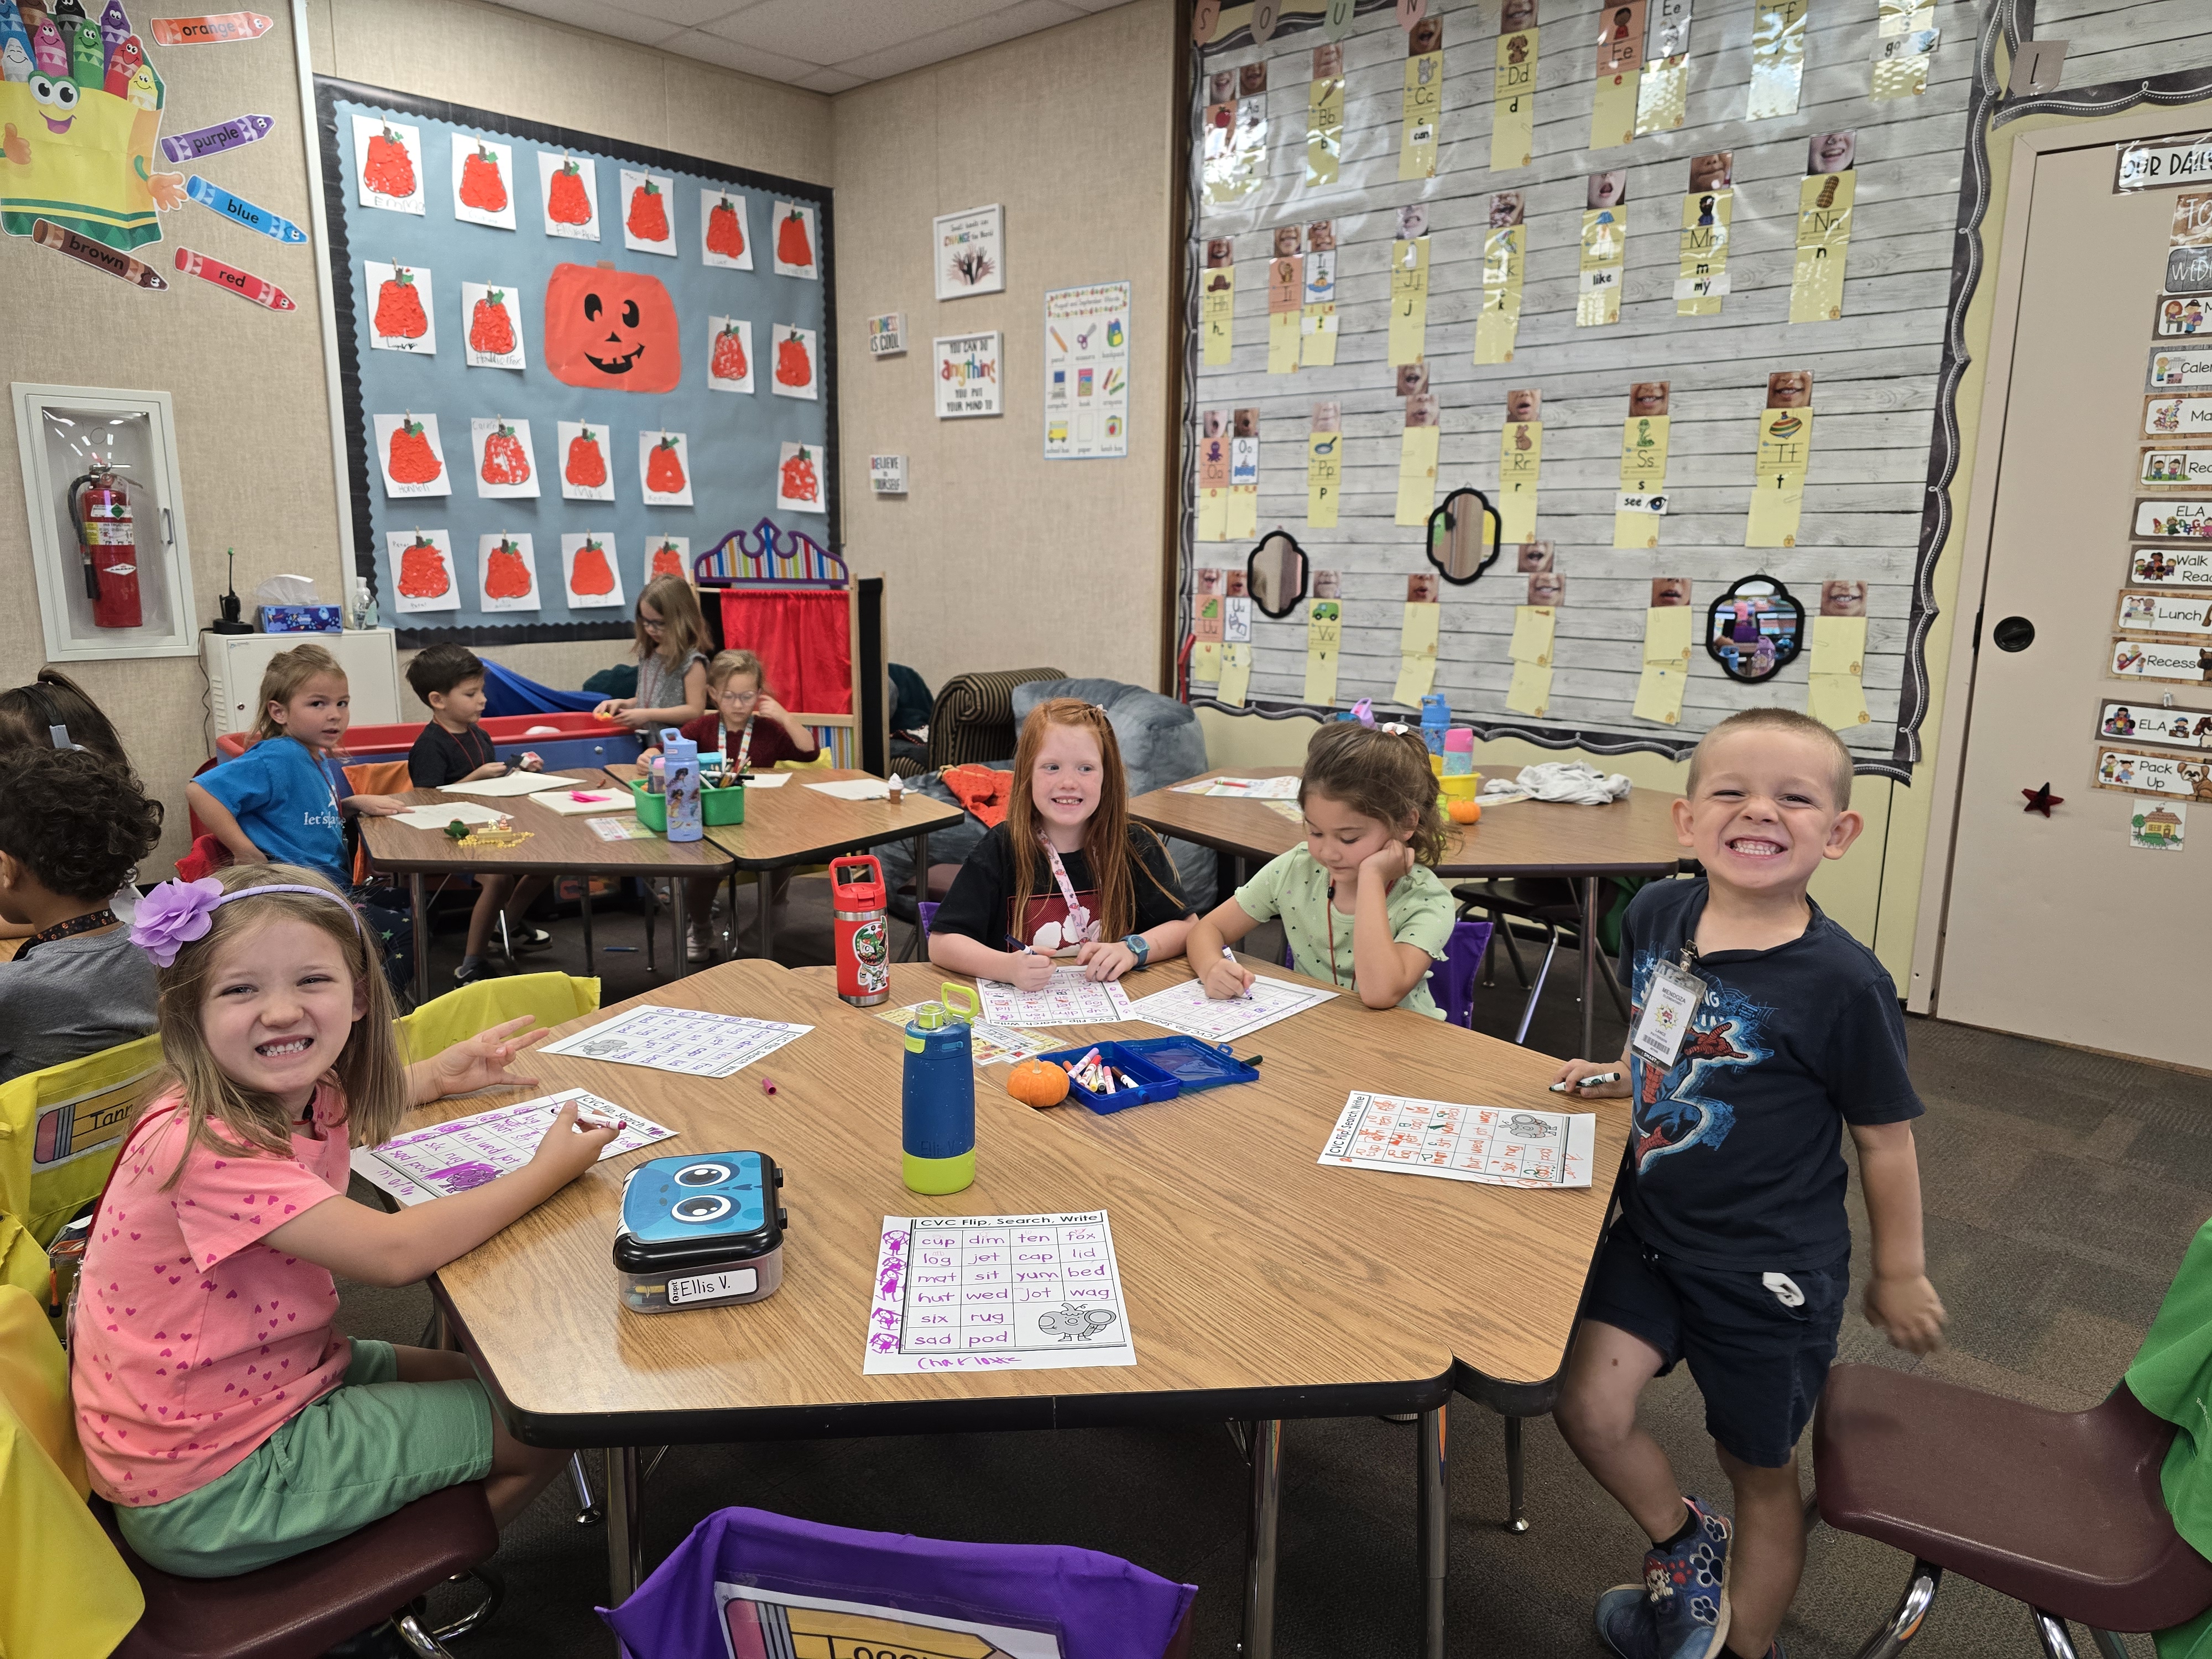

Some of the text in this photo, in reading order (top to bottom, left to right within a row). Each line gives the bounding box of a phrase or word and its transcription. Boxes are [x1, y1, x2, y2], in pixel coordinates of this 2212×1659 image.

[1199, 8, 1211, 29] S
[1260, 6, 1270, 29] O
[1334, 3, 1345, 25] U
[182, 20, 236, 36] orange
[1611, 43, 1633, 62] Ee
[1509, 65, 1529, 85] Dd
[1415, 87, 1434, 105] Cc
[1510, 97, 1517, 112] d
[193, 127, 239, 152] purple
[2123, 156, 2161, 178] OUR
[227, 199, 259, 224] blue
[1814, 212, 1841, 232] Nn
[69, 236, 124, 270] brown
[1817, 247, 1827, 259] n
[1697, 264, 1709, 274] m
[219, 269, 246, 288] red
[1593, 272, 1612, 284] like
[1694, 280, 1711, 295] my
[1514, 453, 1531, 469] Rr
[1637, 451, 1655, 467] Ss
[1776, 444, 1796, 463] Tt
[871, 457, 899, 469] BELIEVE
[1318, 461, 1334, 479] Pp
[1515, 482, 1521, 492] r
[1777, 474, 1783, 488] t
[1624, 497, 1641, 507] see
[2176, 505, 2205, 517] ELA
[2177, 555, 2208, 566] Walk
[2158, 608, 2201, 622] Lunch
[1318, 627, 1335, 641] Vv
[2147, 655, 2196, 669] Recess
[2138, 719, 2167, 732] ELA
[2140, 760, 2172, 775] Pack
[2147, 776, 2164, 789] Up
[1662, 987, 1686, 1004] MENDOZA
[638, 1015, 659, 1024] sad
[618, 1024, 636, 1034] pod
[637, 1028, 659, 1037] rug
[751, 1030, 770, 1039] cup
[662, 1042, 684, 1053] yum
[687, 1047, 707, 1057] cap
[583, 1096, 604, 1107] CVC
[615, 1112, 646, 1129] Search,
[1330, 1096, 1365, 1154] CVC Flip, Search, Write
[1366, 1145, 1384, 1156] cup
[1469, 1140, 1484, 1154] wed
[389, 1150, 418, 1161] sad
[1460, 1156, 1483, 1169] hut
[403, 1162, 439, 1172] pod
[922, 1231, 1095, 1248] cup dim ten fox
[924, 1248, 1095, 1266] log jet cap lid
[918, 1265, 1104, 1283] mat sit yum bed
[681, 1275, 731, 1297] Ellis V.
[919, 1287, 1109, 1303] hut wed jot wag
[921, 1313, 1004, 1324] six rug
[915, 1332, 1008, 1347] sad pod
